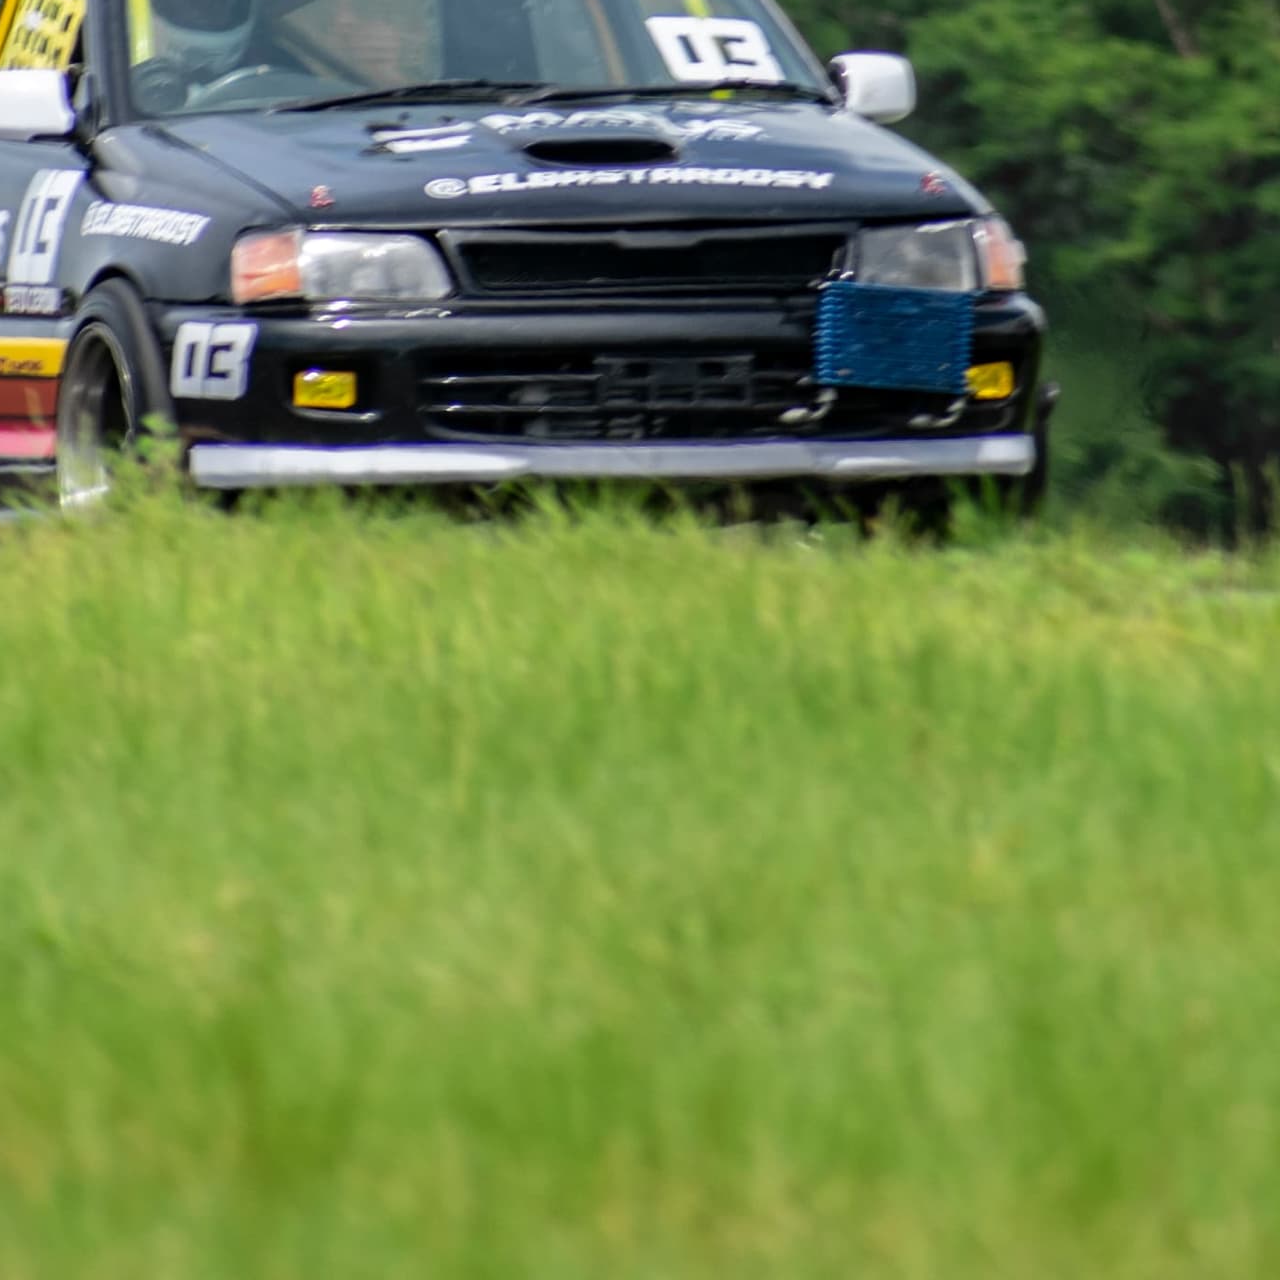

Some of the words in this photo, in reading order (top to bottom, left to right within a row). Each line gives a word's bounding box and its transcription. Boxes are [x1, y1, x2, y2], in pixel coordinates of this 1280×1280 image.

[645, 16, 785, 83] 03
[8, 168, 83, 284] 03
[171, 322, 258, 400] 03
